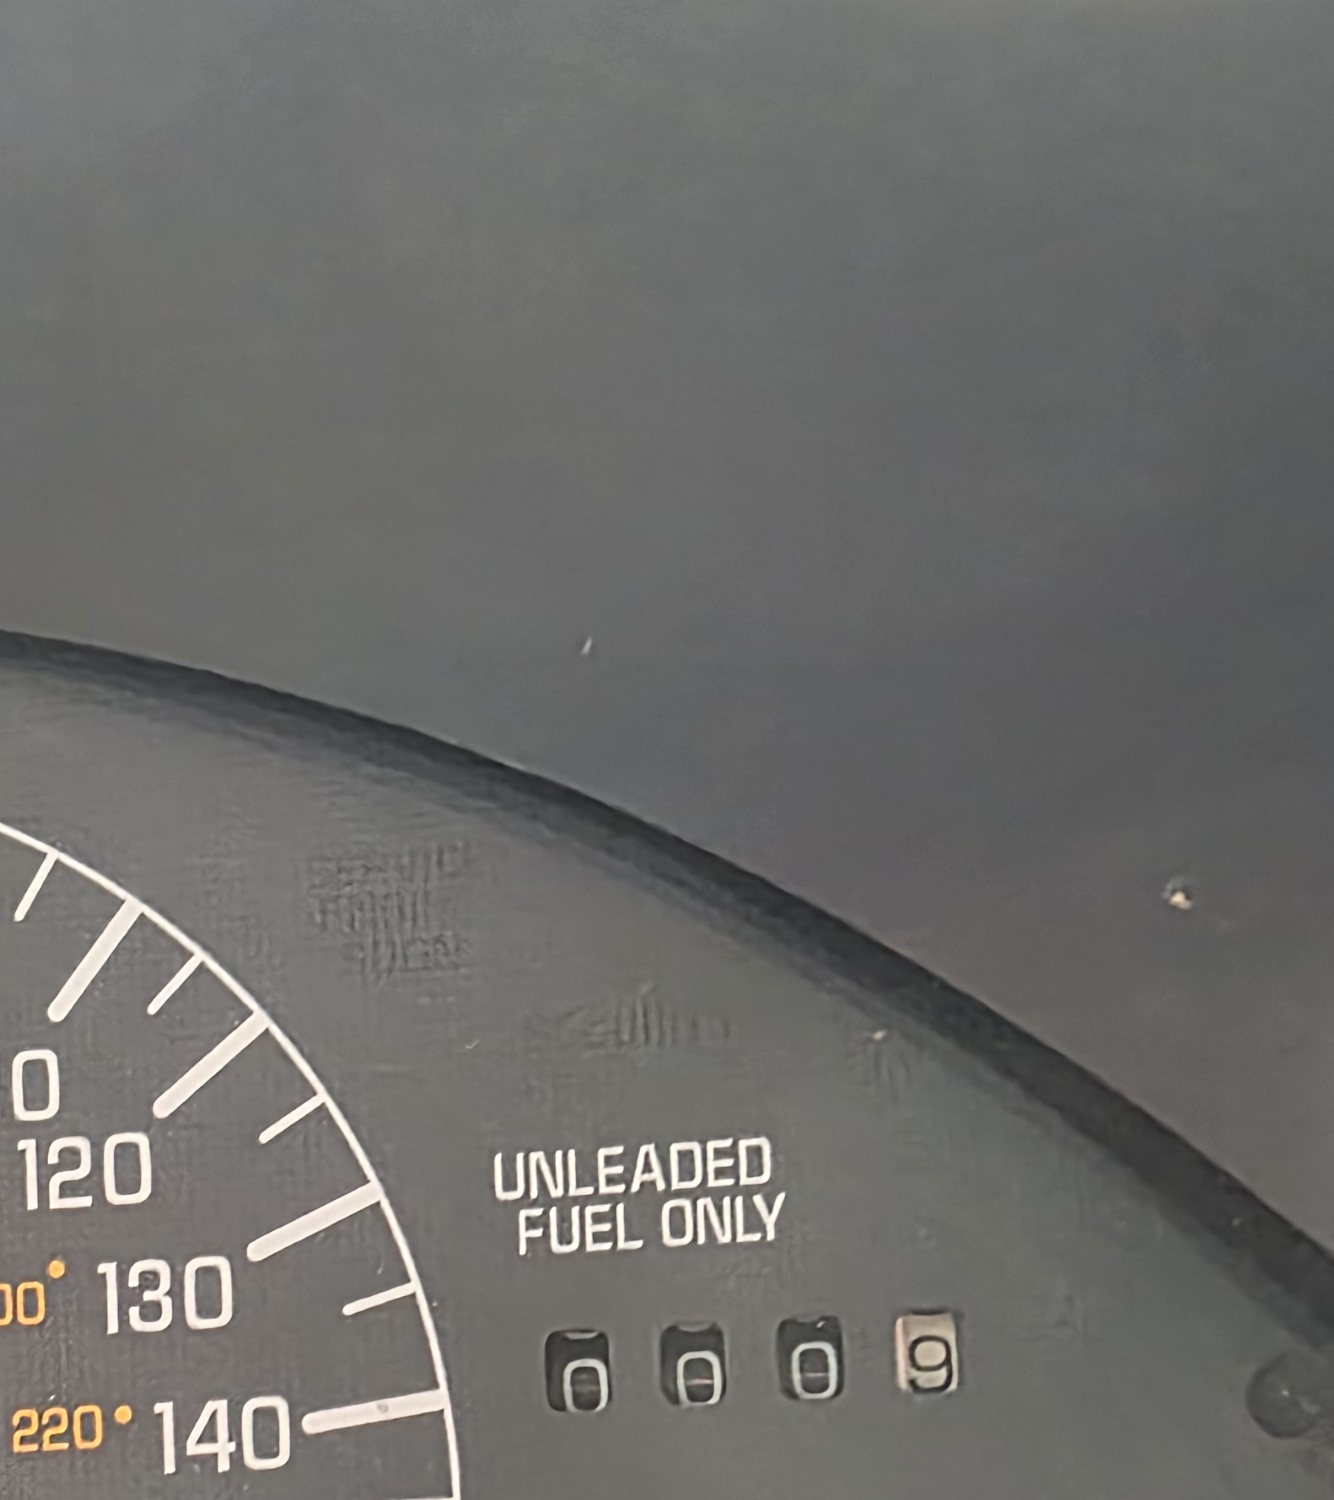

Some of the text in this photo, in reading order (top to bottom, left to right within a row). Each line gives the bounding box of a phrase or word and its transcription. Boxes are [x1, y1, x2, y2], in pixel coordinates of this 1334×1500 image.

[16, 1131, 153, 1212] 120
[492, 1135, 773, 1201] UNLEADED
[517, 1190, 787, 1257] FUEL ONLY
[96, 1254, 234, 1336] 130
[10, 1403, 104, 1454] 220
[152, 1394, 292, 1476] 140
